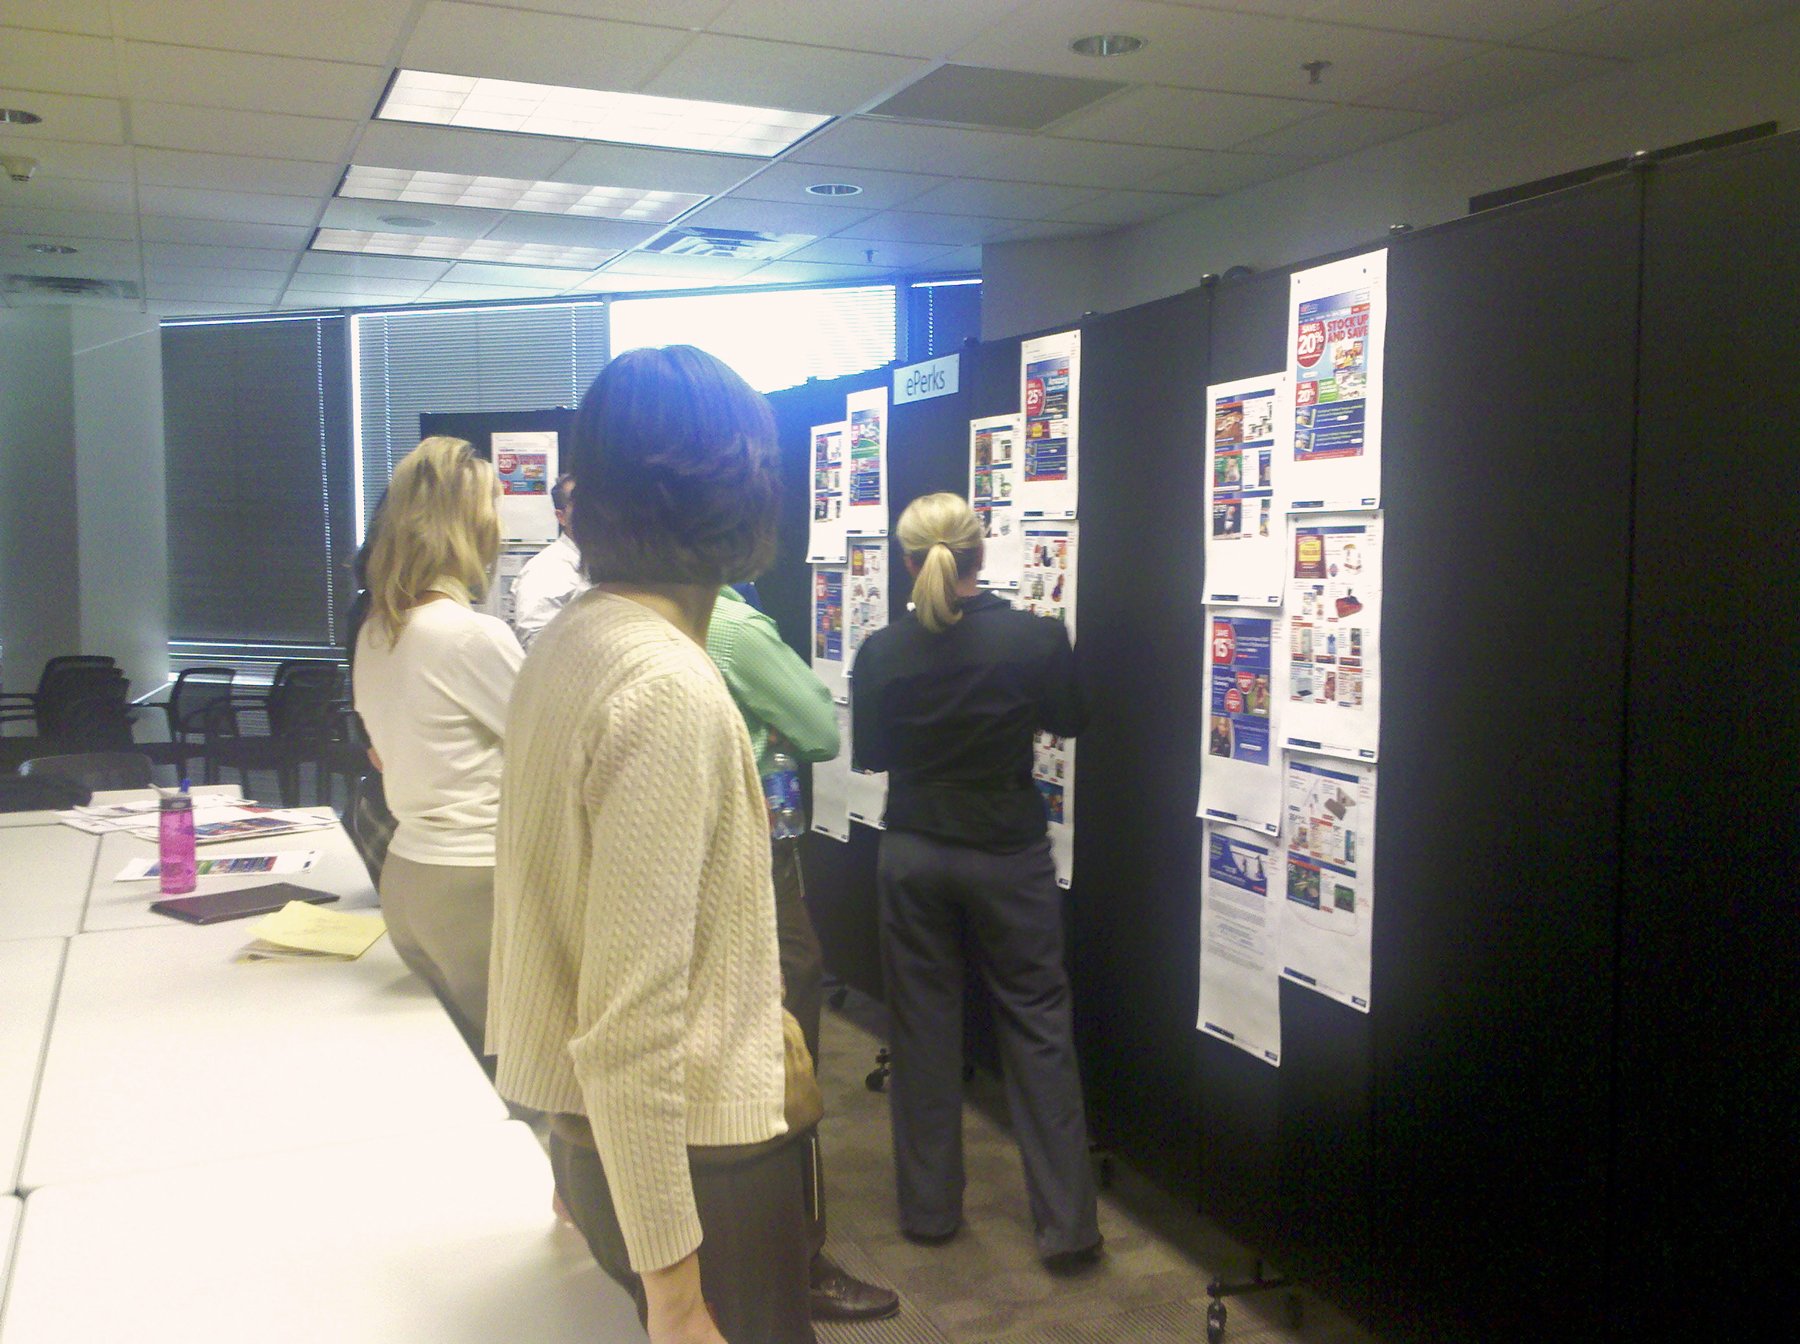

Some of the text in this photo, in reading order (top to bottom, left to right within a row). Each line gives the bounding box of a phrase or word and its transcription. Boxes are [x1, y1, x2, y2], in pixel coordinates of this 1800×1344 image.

[1327, 315, 1355, 332] STOCK
[1356, 314, 1369, 327] UP
[1298, 331, 1324, 355] 20%
[1327, 325, 1368, 343] AND SAVE
[907, 364, 946, 396] ePerks
